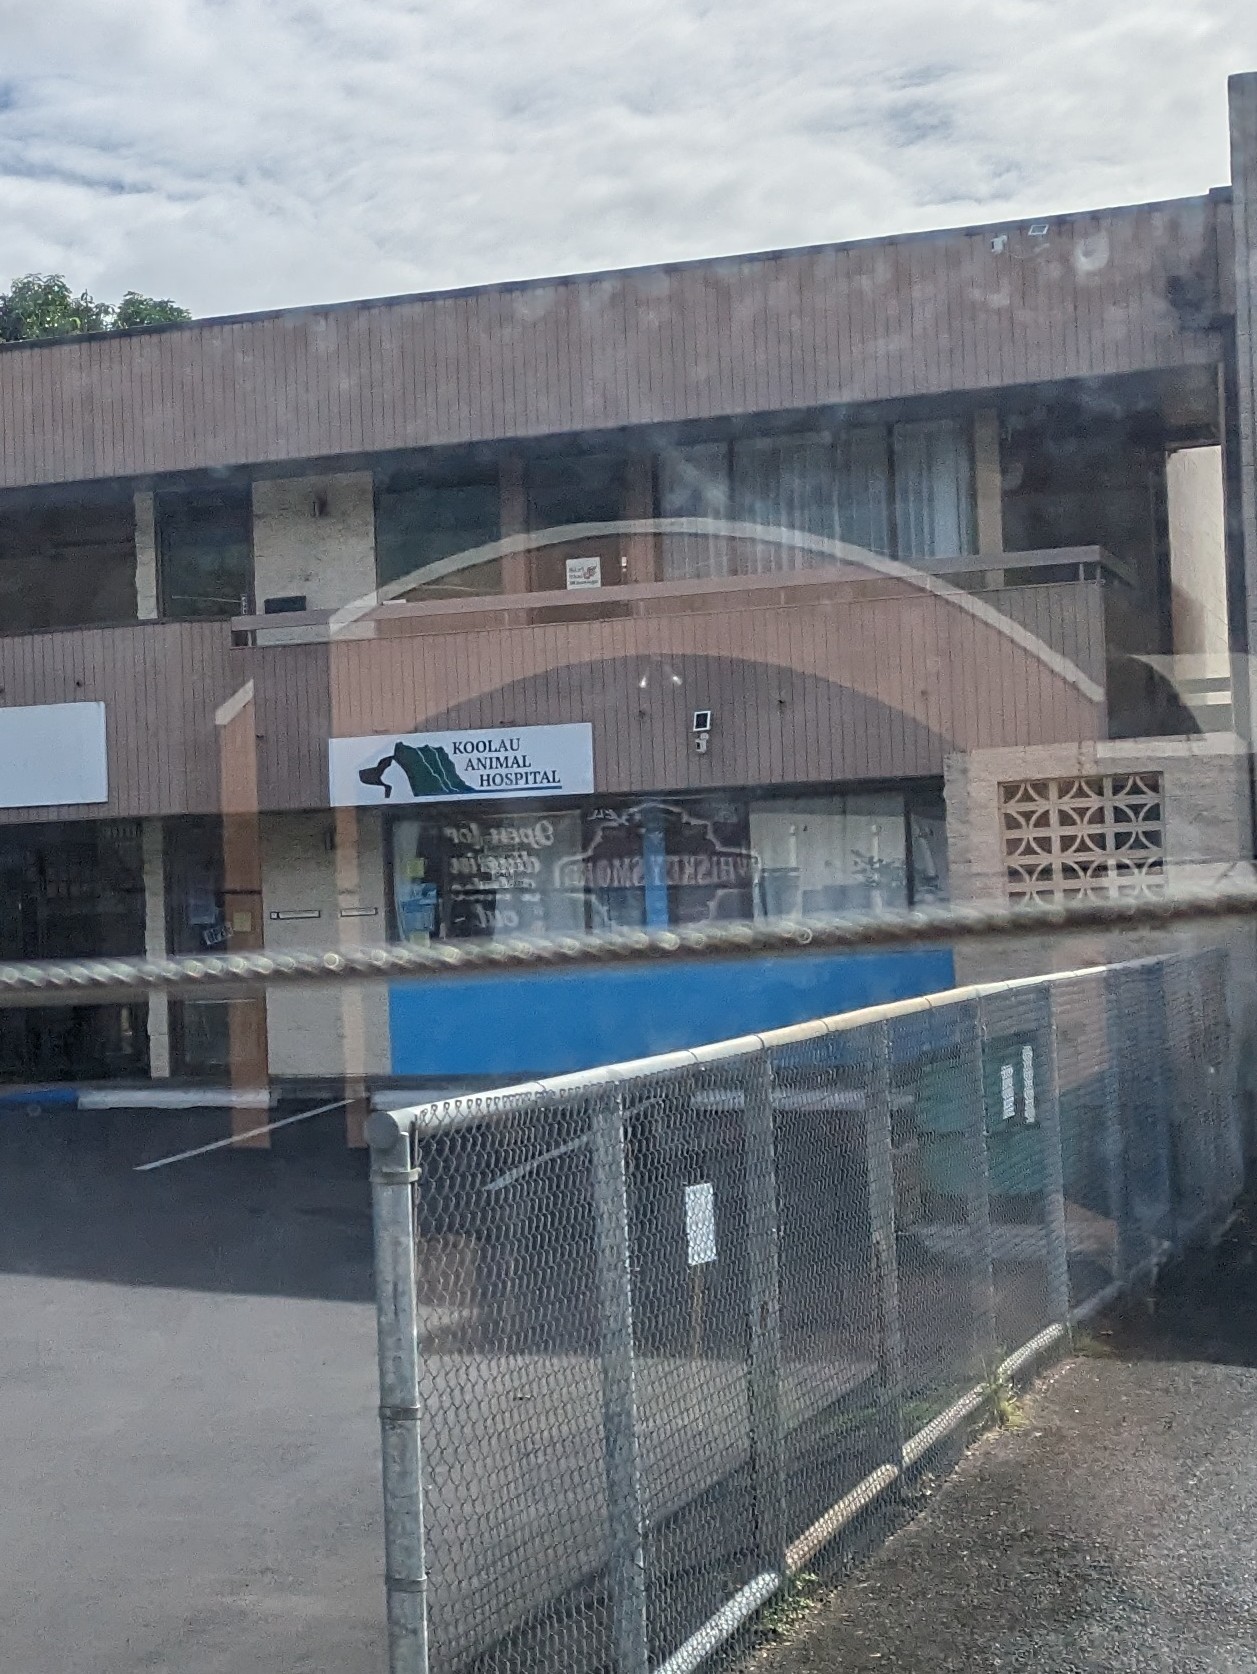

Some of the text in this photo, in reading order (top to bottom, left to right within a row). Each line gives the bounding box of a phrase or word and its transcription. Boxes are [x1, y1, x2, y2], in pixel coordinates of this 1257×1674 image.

[452, 738, 520, 755] KOOLAU
[464, 754, 532, 772] ANIMAL
[479, 769, 561, 787] HOSPITAL
